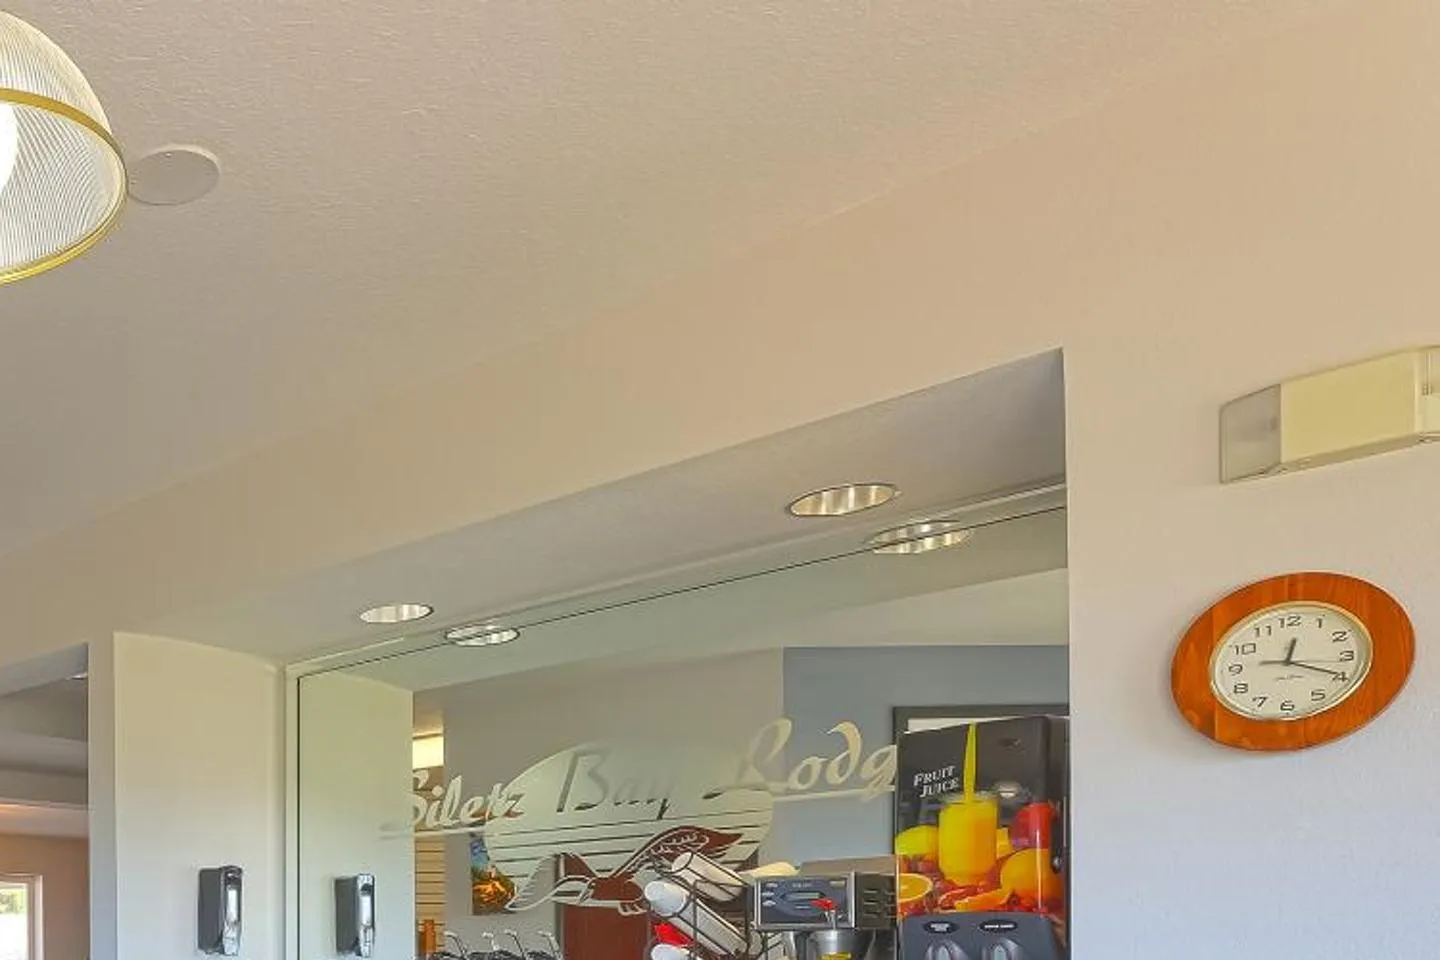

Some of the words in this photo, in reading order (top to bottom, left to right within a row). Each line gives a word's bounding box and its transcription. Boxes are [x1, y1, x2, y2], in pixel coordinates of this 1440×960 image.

[1277, 615, 1302, 629] 12
[1316, 616, 1324, 628] 1
[1254, 625, 1272, 637] 11
[1331, 630, 1349, 643] 2
[1232, 643, 1257, 656] 10
[1339, 650, 1355, 663] 3
[1228, 663, 1244, 677] 9
[1331, 670, 1349, 683] 4
[1233, 683, 1249, 695] 8
[1310, 688, 1327, 702] 5
[1252, 697, 1268, 708] 7
[1279, 700, 1296, 713] 6
[556, 748, 673, 820] Bay
[704, 717, 898, 802] Lodg
[913, 764, 956, 787] FRUIT
[919, 776, 959, 798] JUICE
